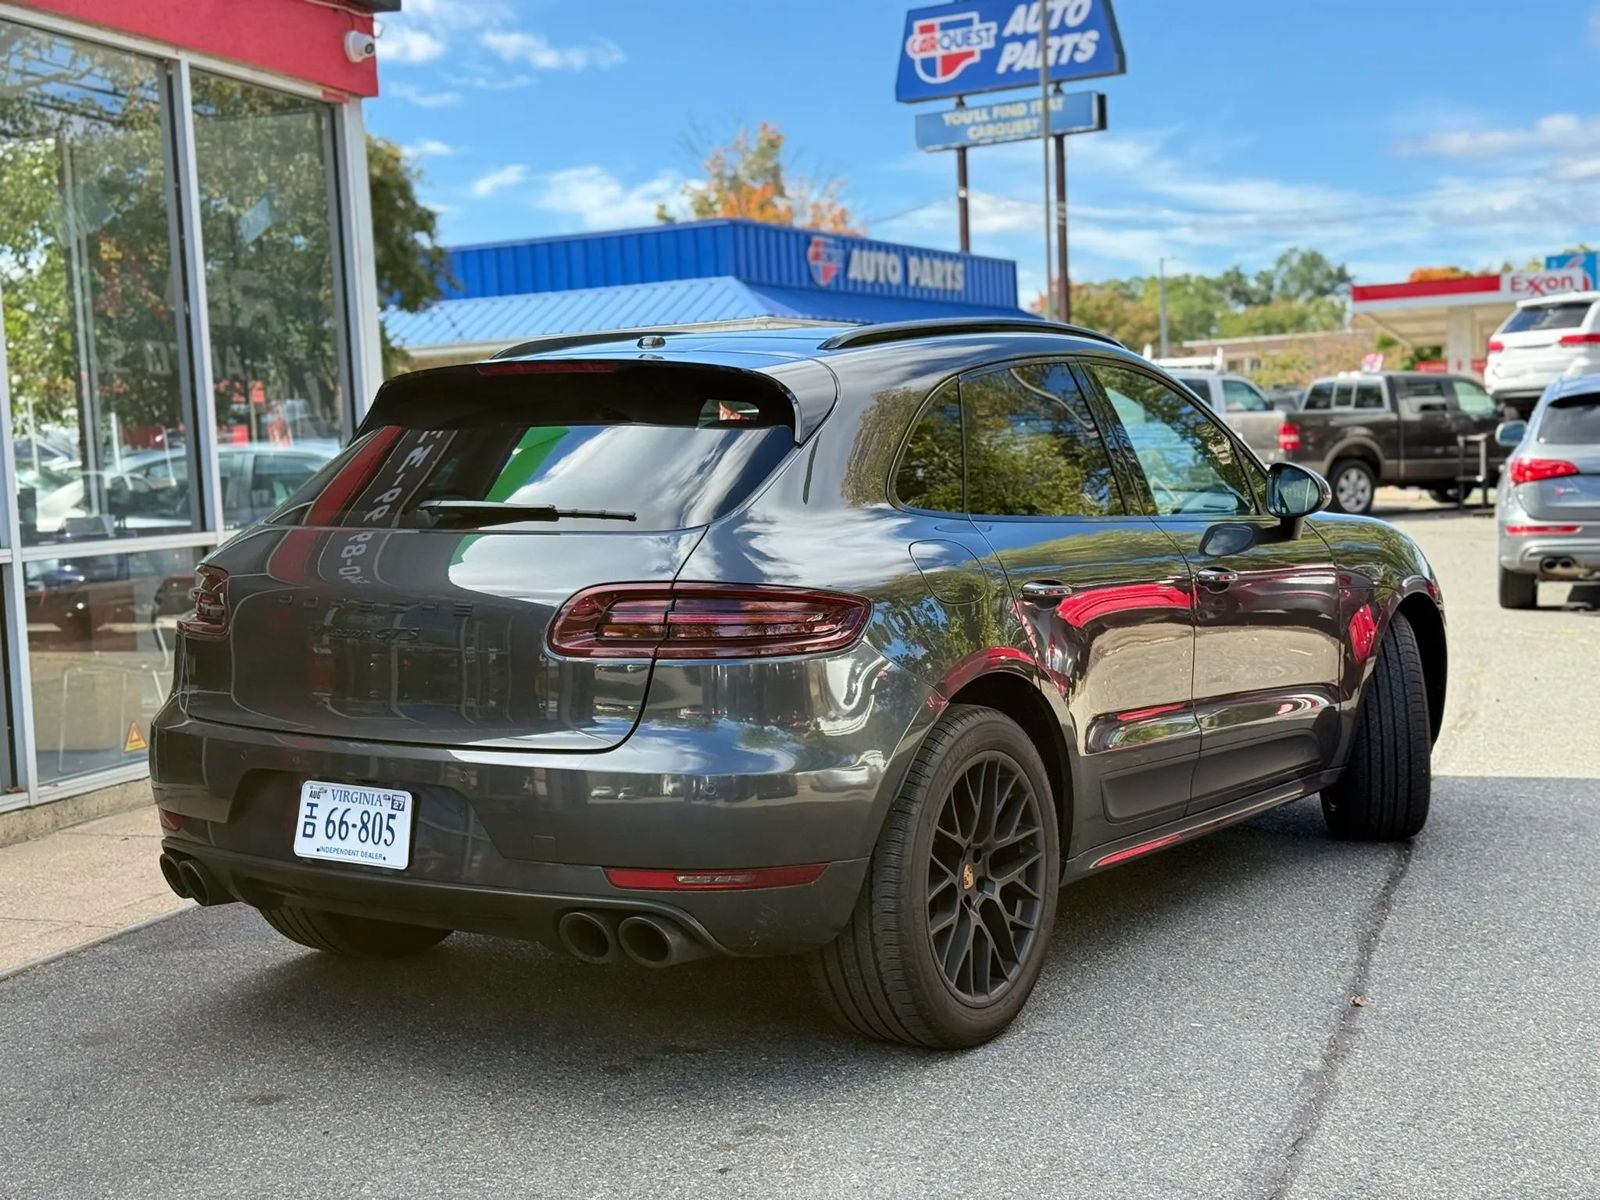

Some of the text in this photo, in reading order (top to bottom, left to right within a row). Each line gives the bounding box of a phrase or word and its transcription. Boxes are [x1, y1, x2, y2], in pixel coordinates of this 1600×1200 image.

[1002, 0, 1092, 37] AUTO
[996, 29, 1100, 74] PARTS
[847, 247, 903, 285] AUTO
[907, 256, 964, 291] PARTS
[1510, 275, 1574, 296] Exxon
[331, 789, 383, 807] VIRGINIA
[393, 801, 403, 810] 27
[325, 807, 397, 847] 66-805
[319, 846, 383, 860] INDEPENDENT DEALER
